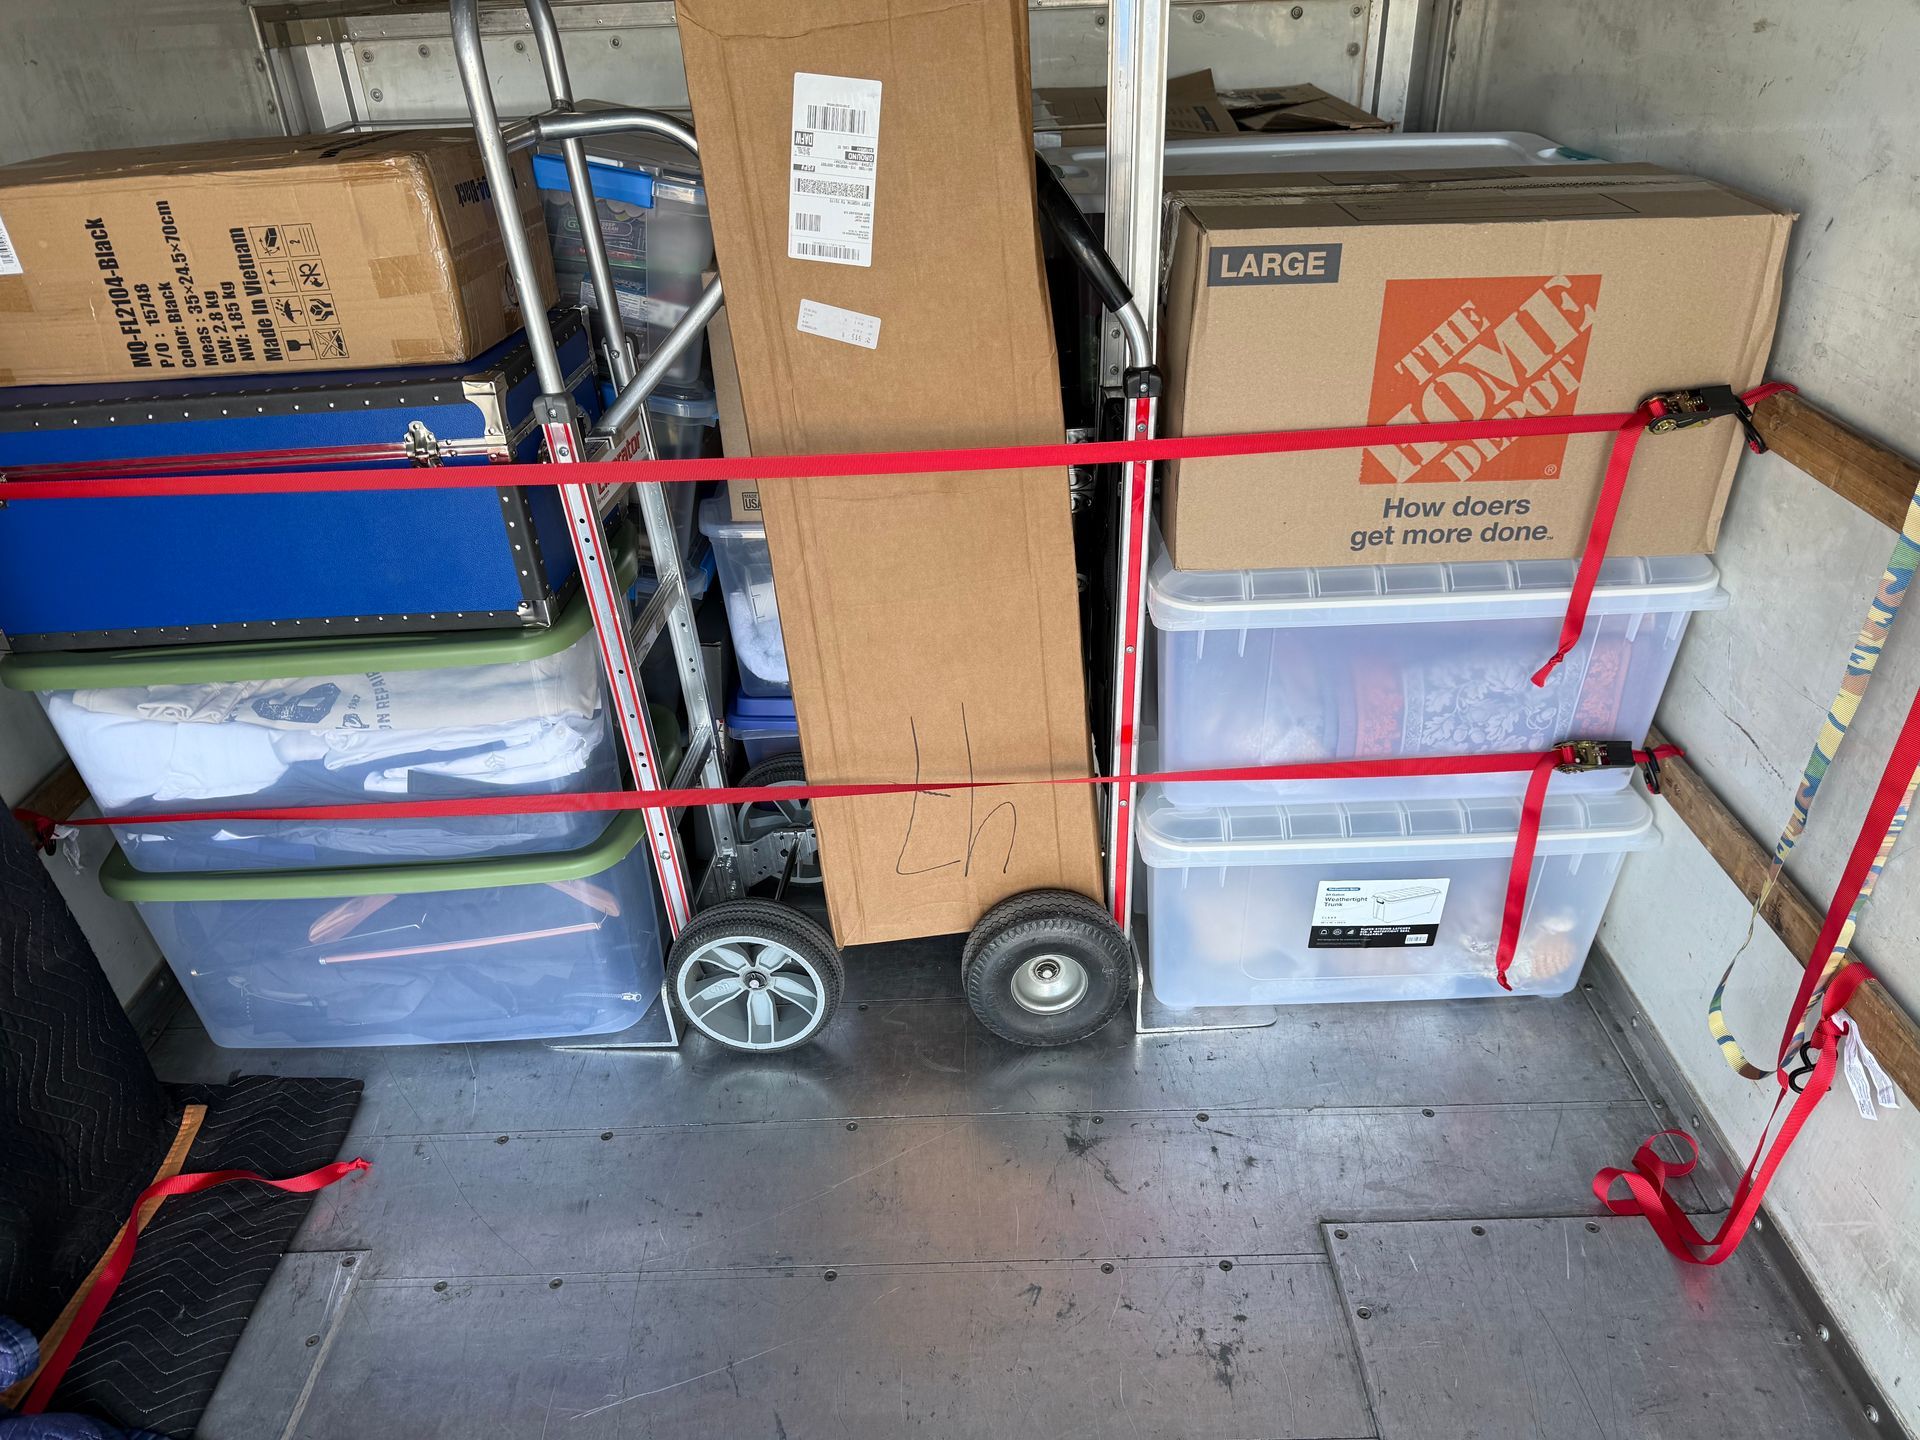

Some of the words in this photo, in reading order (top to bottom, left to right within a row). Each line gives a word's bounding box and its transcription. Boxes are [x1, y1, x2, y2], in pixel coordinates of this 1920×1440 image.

[847, 153, 874, 162] GROUND
[228, 227, 263, 296] Vietnam
[1220, 251, 1327, 279] LARGE
[84, 217, 152, 368] MQ-FL2104-Black
[157, 281, 183, 323] Black
[203, 290, 220, 308] kg
[219, 281, 236, 300] kg
[134, 283, 161, 327] 15748
[226, 303, 246, 331] 1.85
[247, 299, 268, 315] In
[210, 312, 228, 334] 2.8
[173, 325, 197, 368] Color:
[217, 336, 237, 363] GW:
[238, 334, 256, 361] NW:
[258, 318, 283, 361] Made
[1393, 299, 1491, 387] THE
[1362, 274, 1596, 484] HOME
[1440, 354, 1582, 483] DEPOT
[1383, 497, 1445, 519] How
[1452, 496, 1531, 516] doers
[1350, 526, 1396, 552] get
[1402, 526, 1473, 546] more
